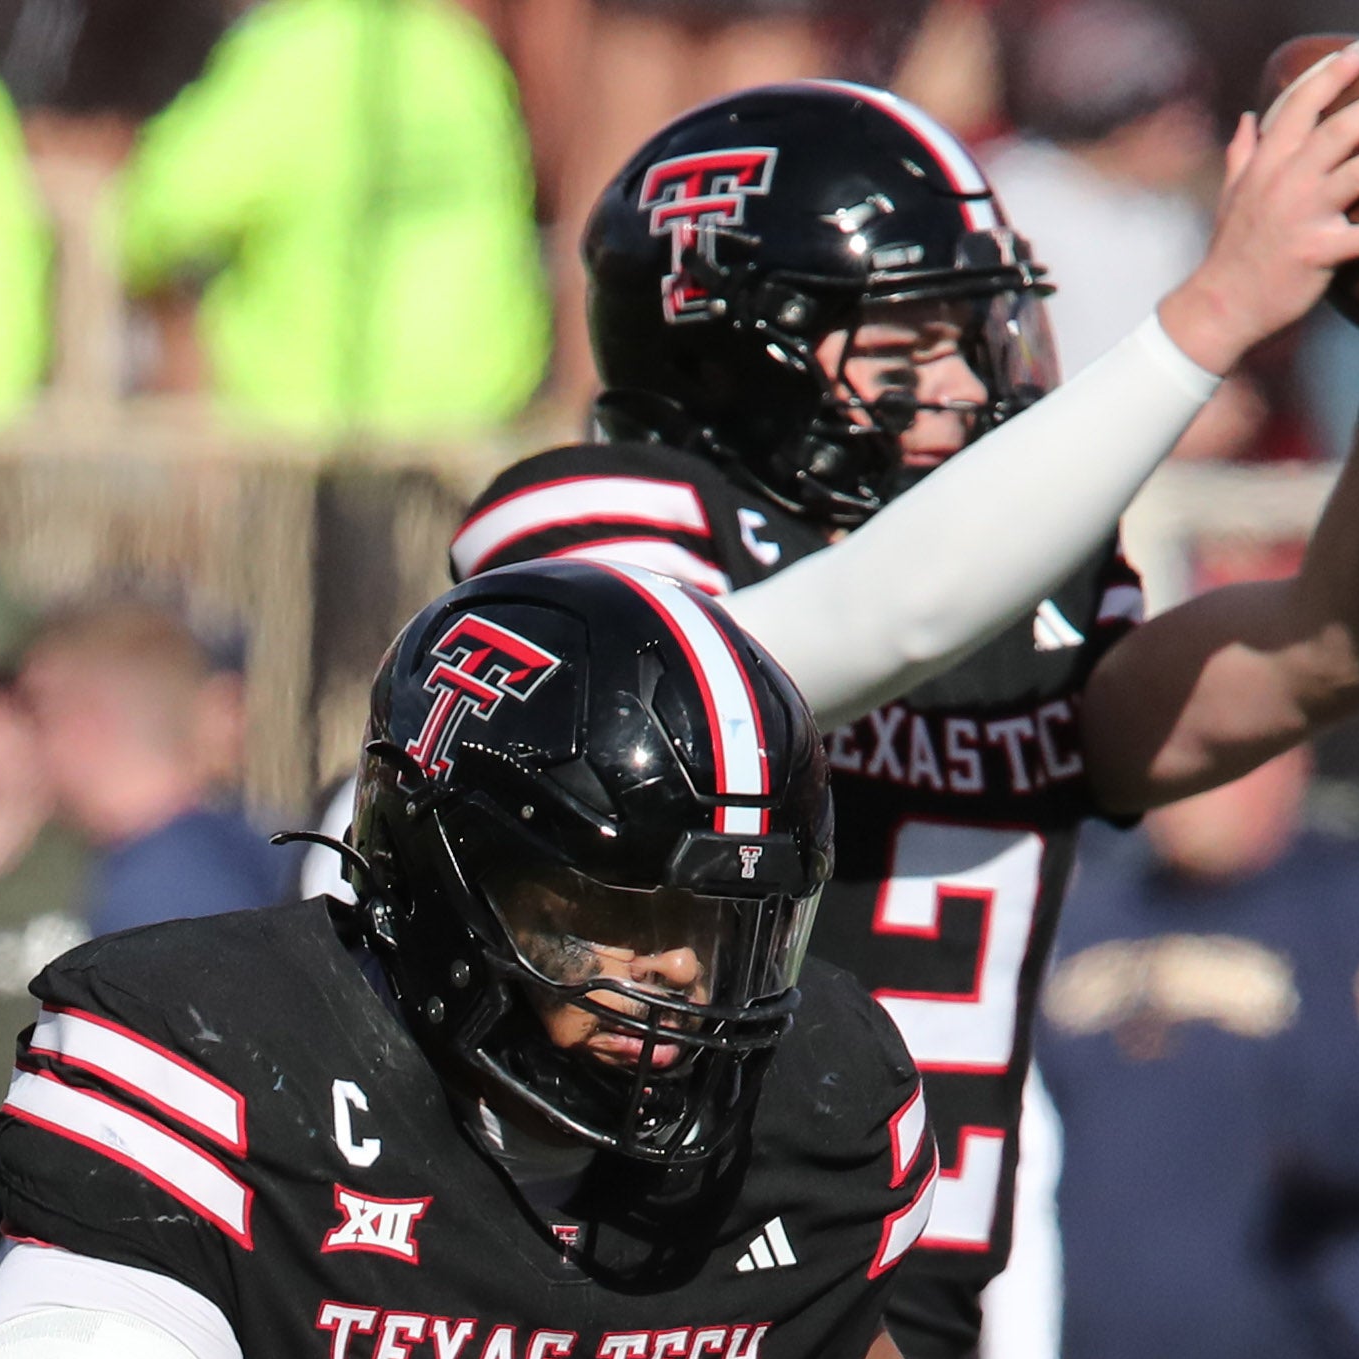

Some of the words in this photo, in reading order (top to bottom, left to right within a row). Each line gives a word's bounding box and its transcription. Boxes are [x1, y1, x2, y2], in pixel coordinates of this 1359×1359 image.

[736, 506, 781, 567] C
[827, 700, 986, 794] EXAS
[871, 815, 1045, 1252] 2
[331, 1078, 382, 1168] C
[321, 1183, 434, 1266] XII
